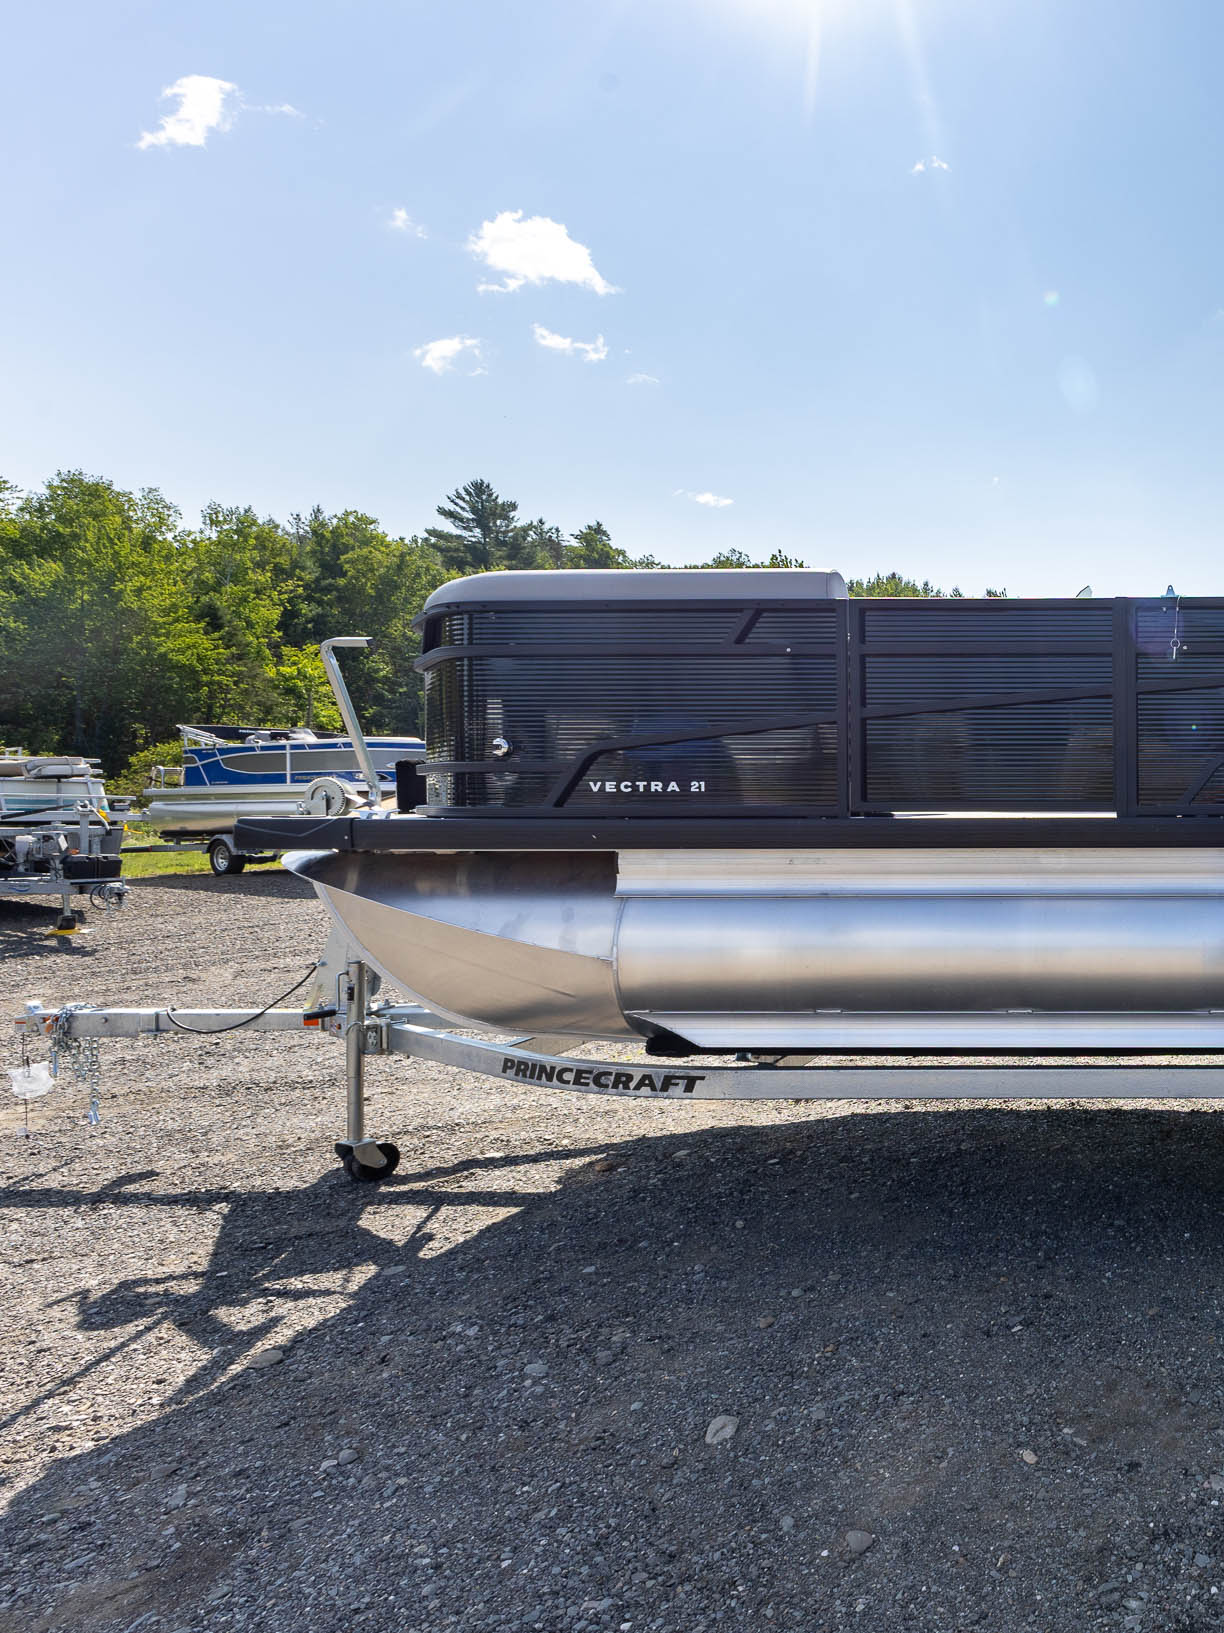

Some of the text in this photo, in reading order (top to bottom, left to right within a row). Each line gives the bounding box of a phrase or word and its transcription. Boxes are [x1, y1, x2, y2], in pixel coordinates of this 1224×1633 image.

[588, 781, 705, 792] VECTRA 21
[501, 1057, 706, 1094] PRINCECRAFT
